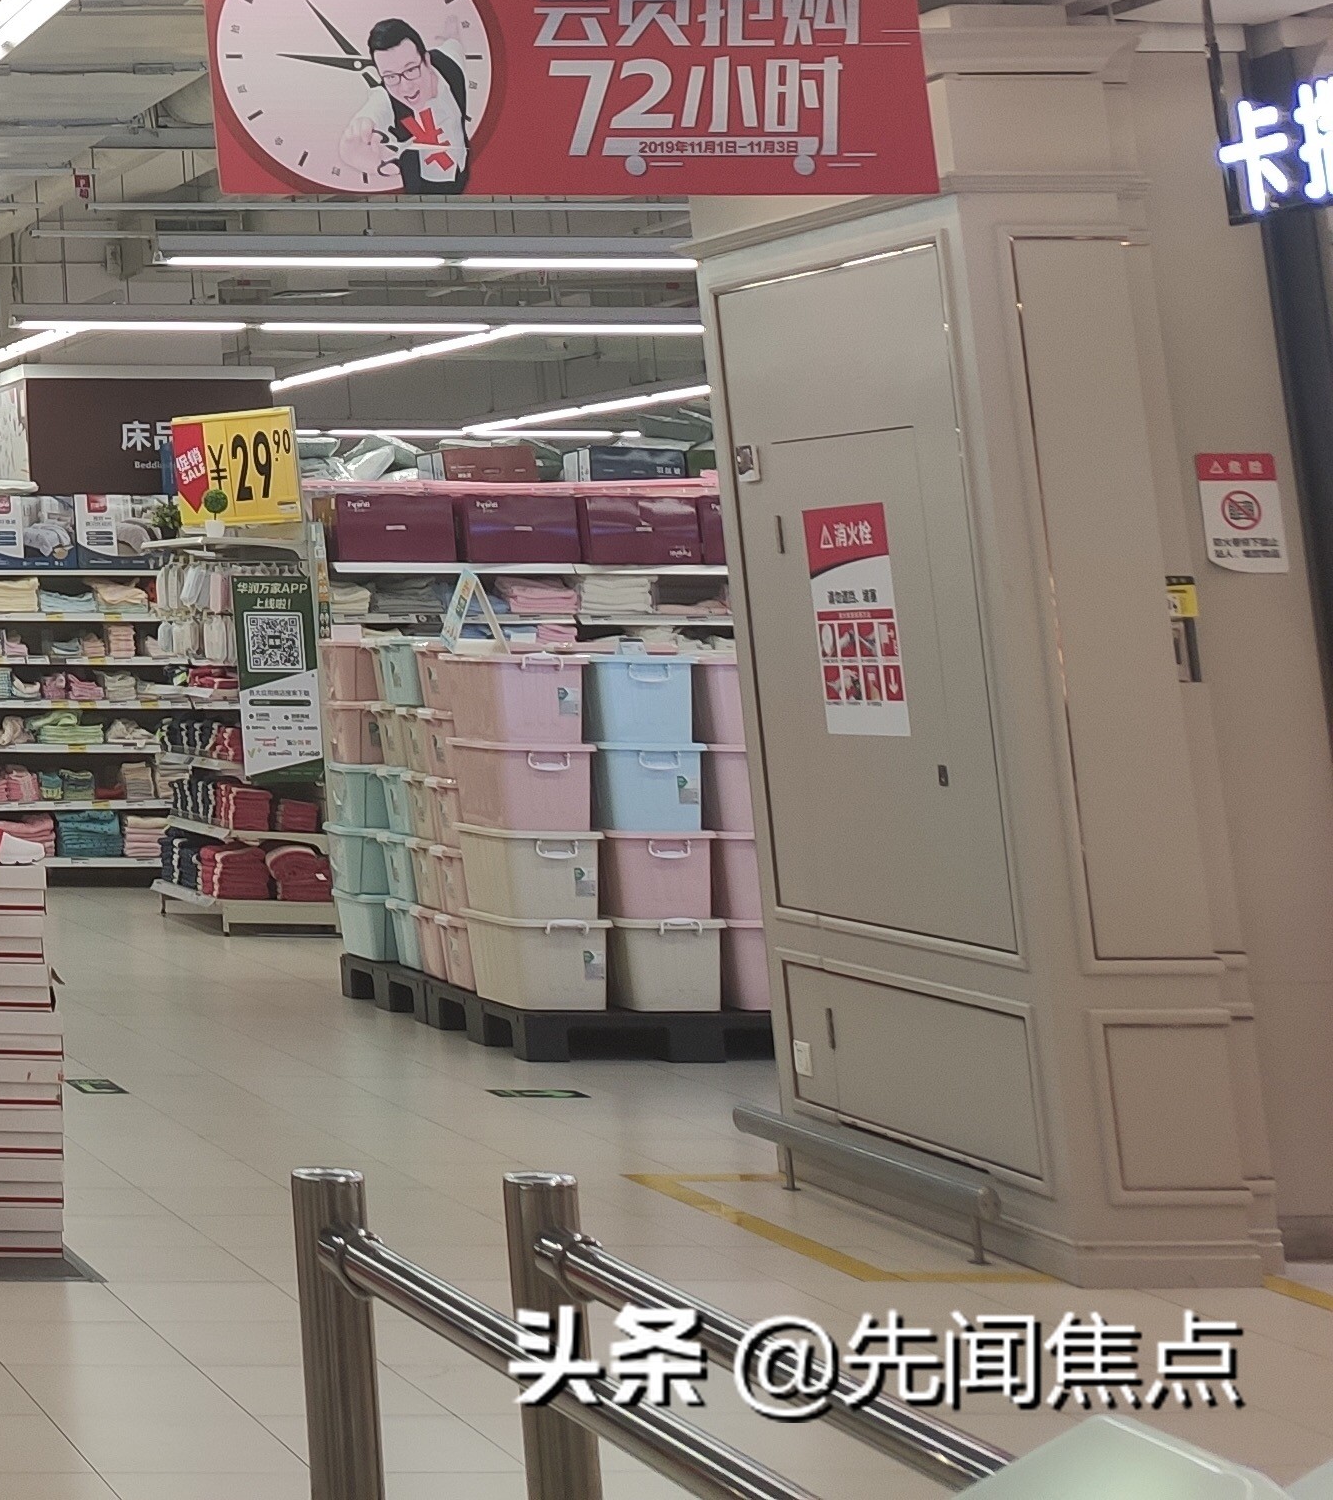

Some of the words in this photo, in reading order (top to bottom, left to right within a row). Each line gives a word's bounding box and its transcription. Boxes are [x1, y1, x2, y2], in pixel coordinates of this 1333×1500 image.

[548, 55, 844, 156] 72小时
[639, 140, 799, 154] 2019年11月1日-11月3日
[176, 445, 205, 471] 促销
[181, 464, 207, 485] SALE
[834, 520, 874, 547] 消火栓
[236, 582, 309, 595] 华润万家APP
